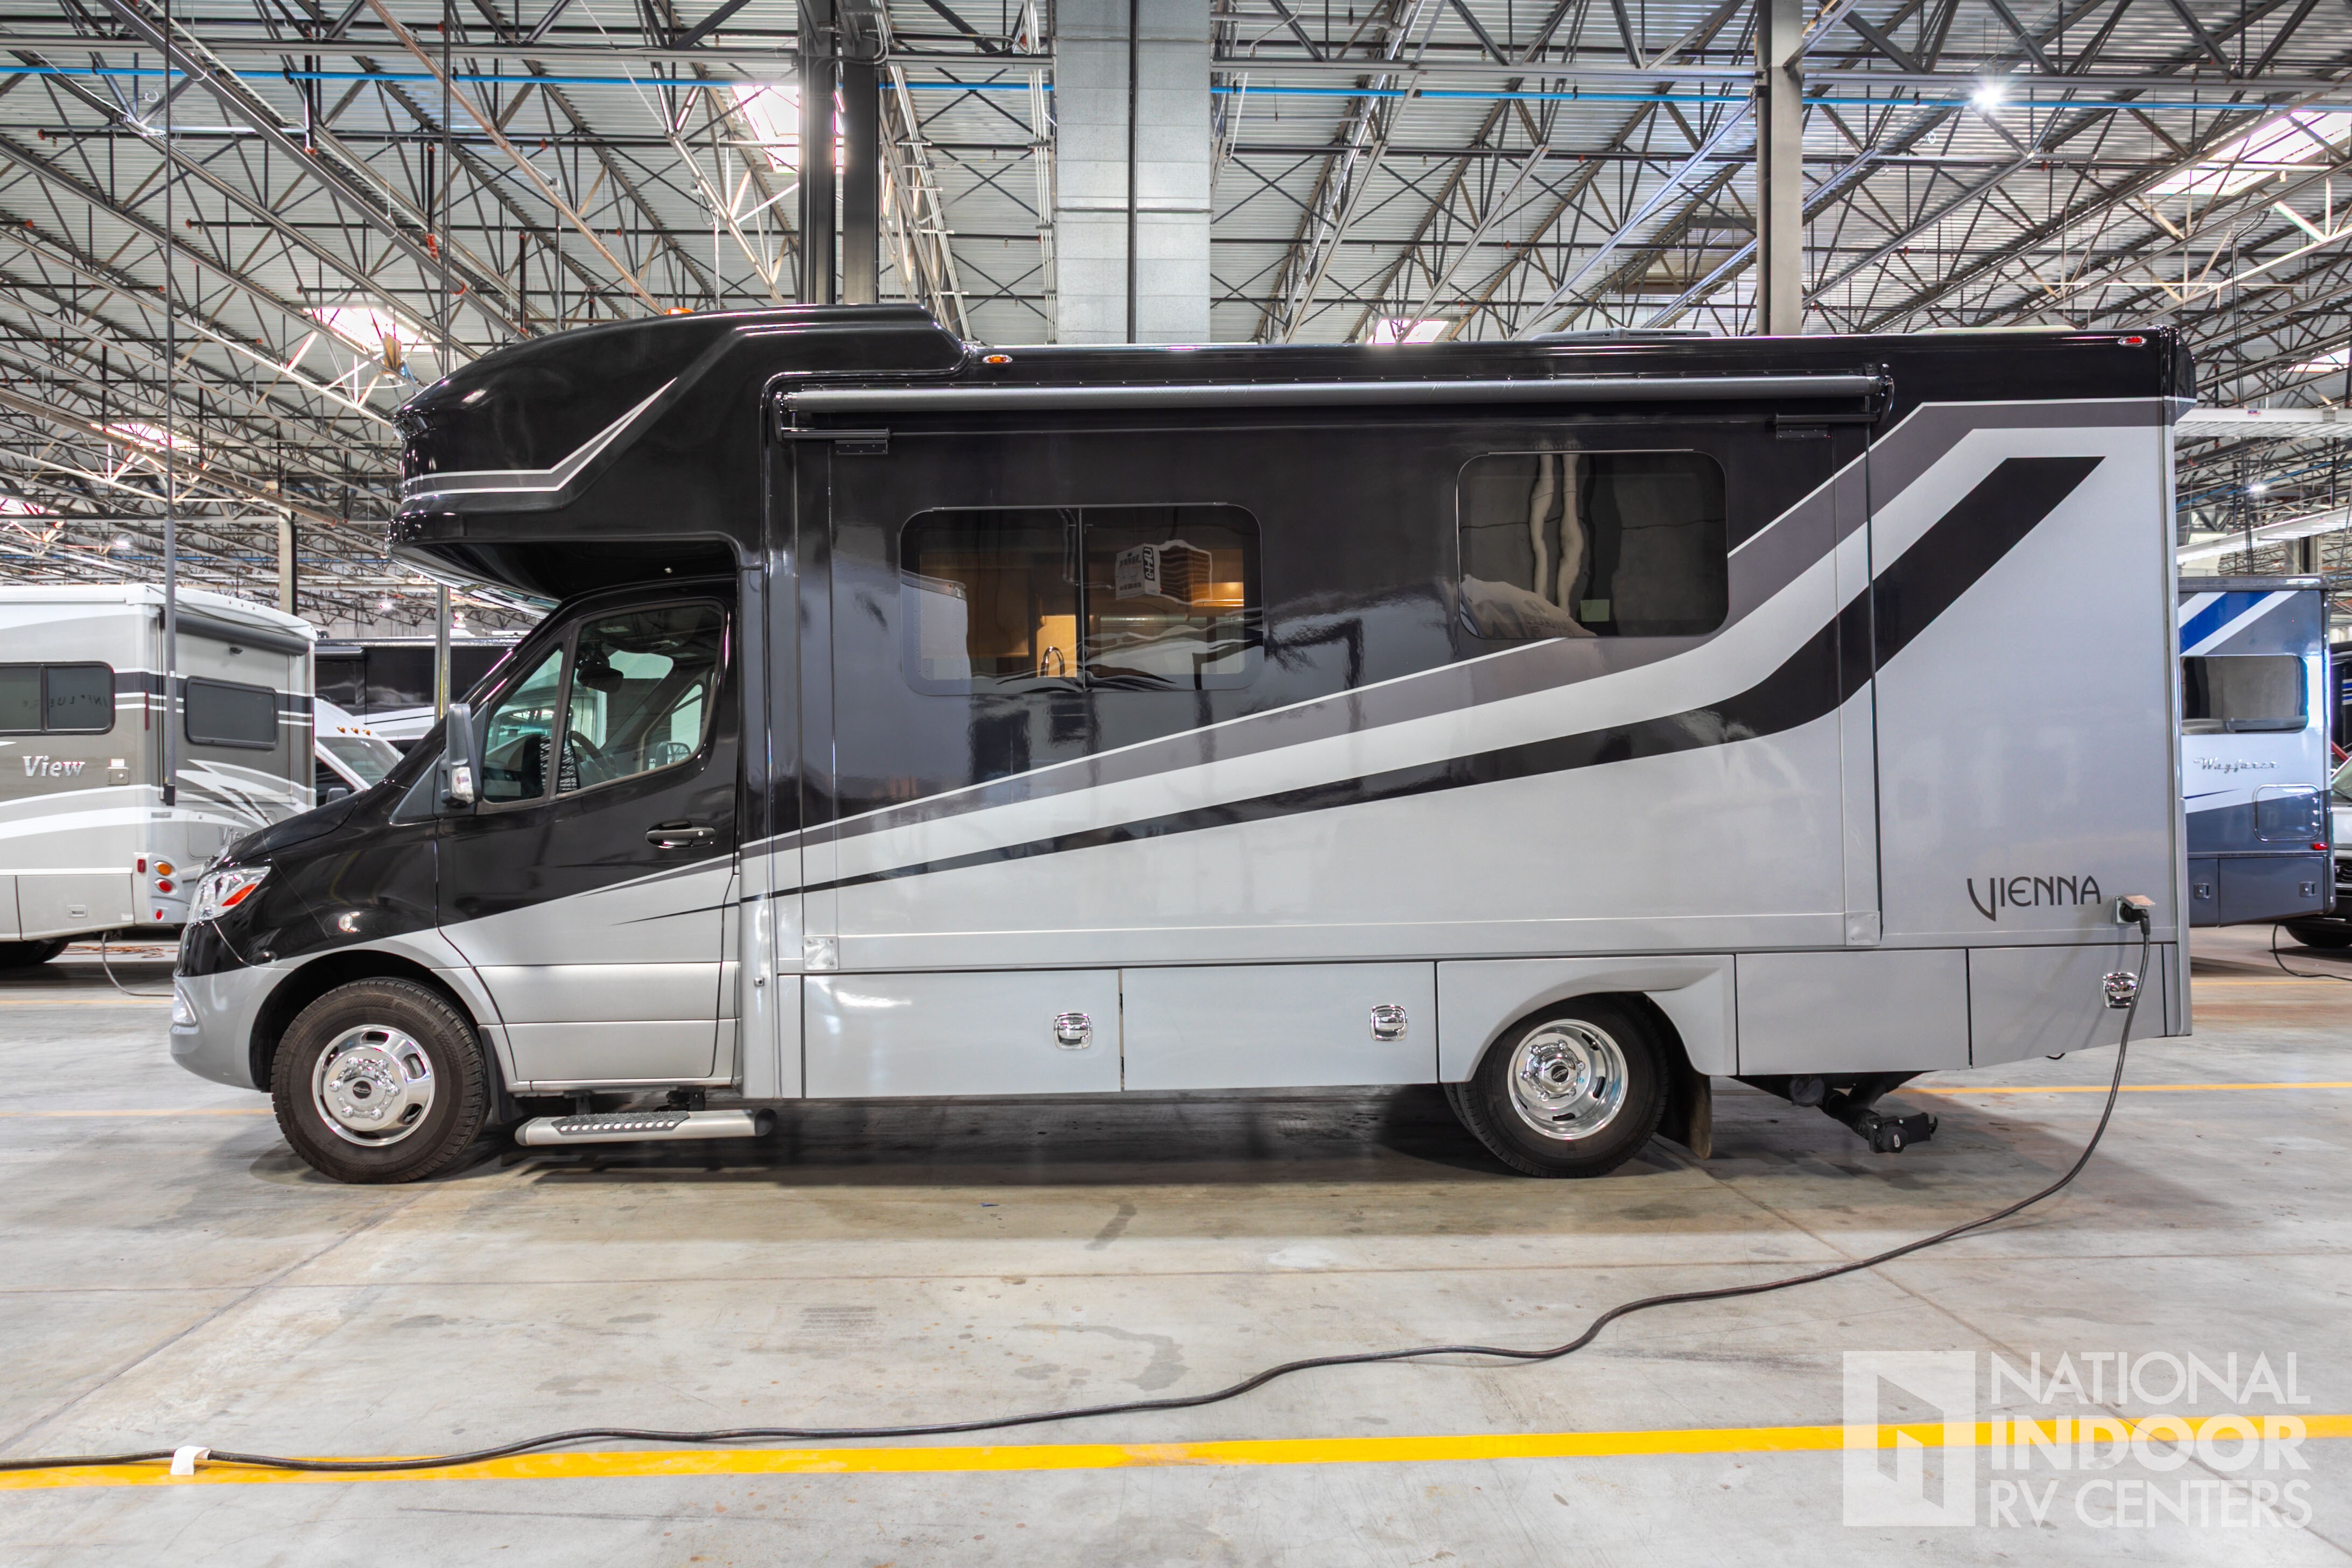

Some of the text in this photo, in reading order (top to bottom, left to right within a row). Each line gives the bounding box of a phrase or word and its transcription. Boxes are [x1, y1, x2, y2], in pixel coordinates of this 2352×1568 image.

[22, 755, 85, 777] View
[2193, 757, 2280, 774] Wayfarer
[1967, 875, 2101, 922] VIENNA
[395, 1002, 434, 1027] Continental
